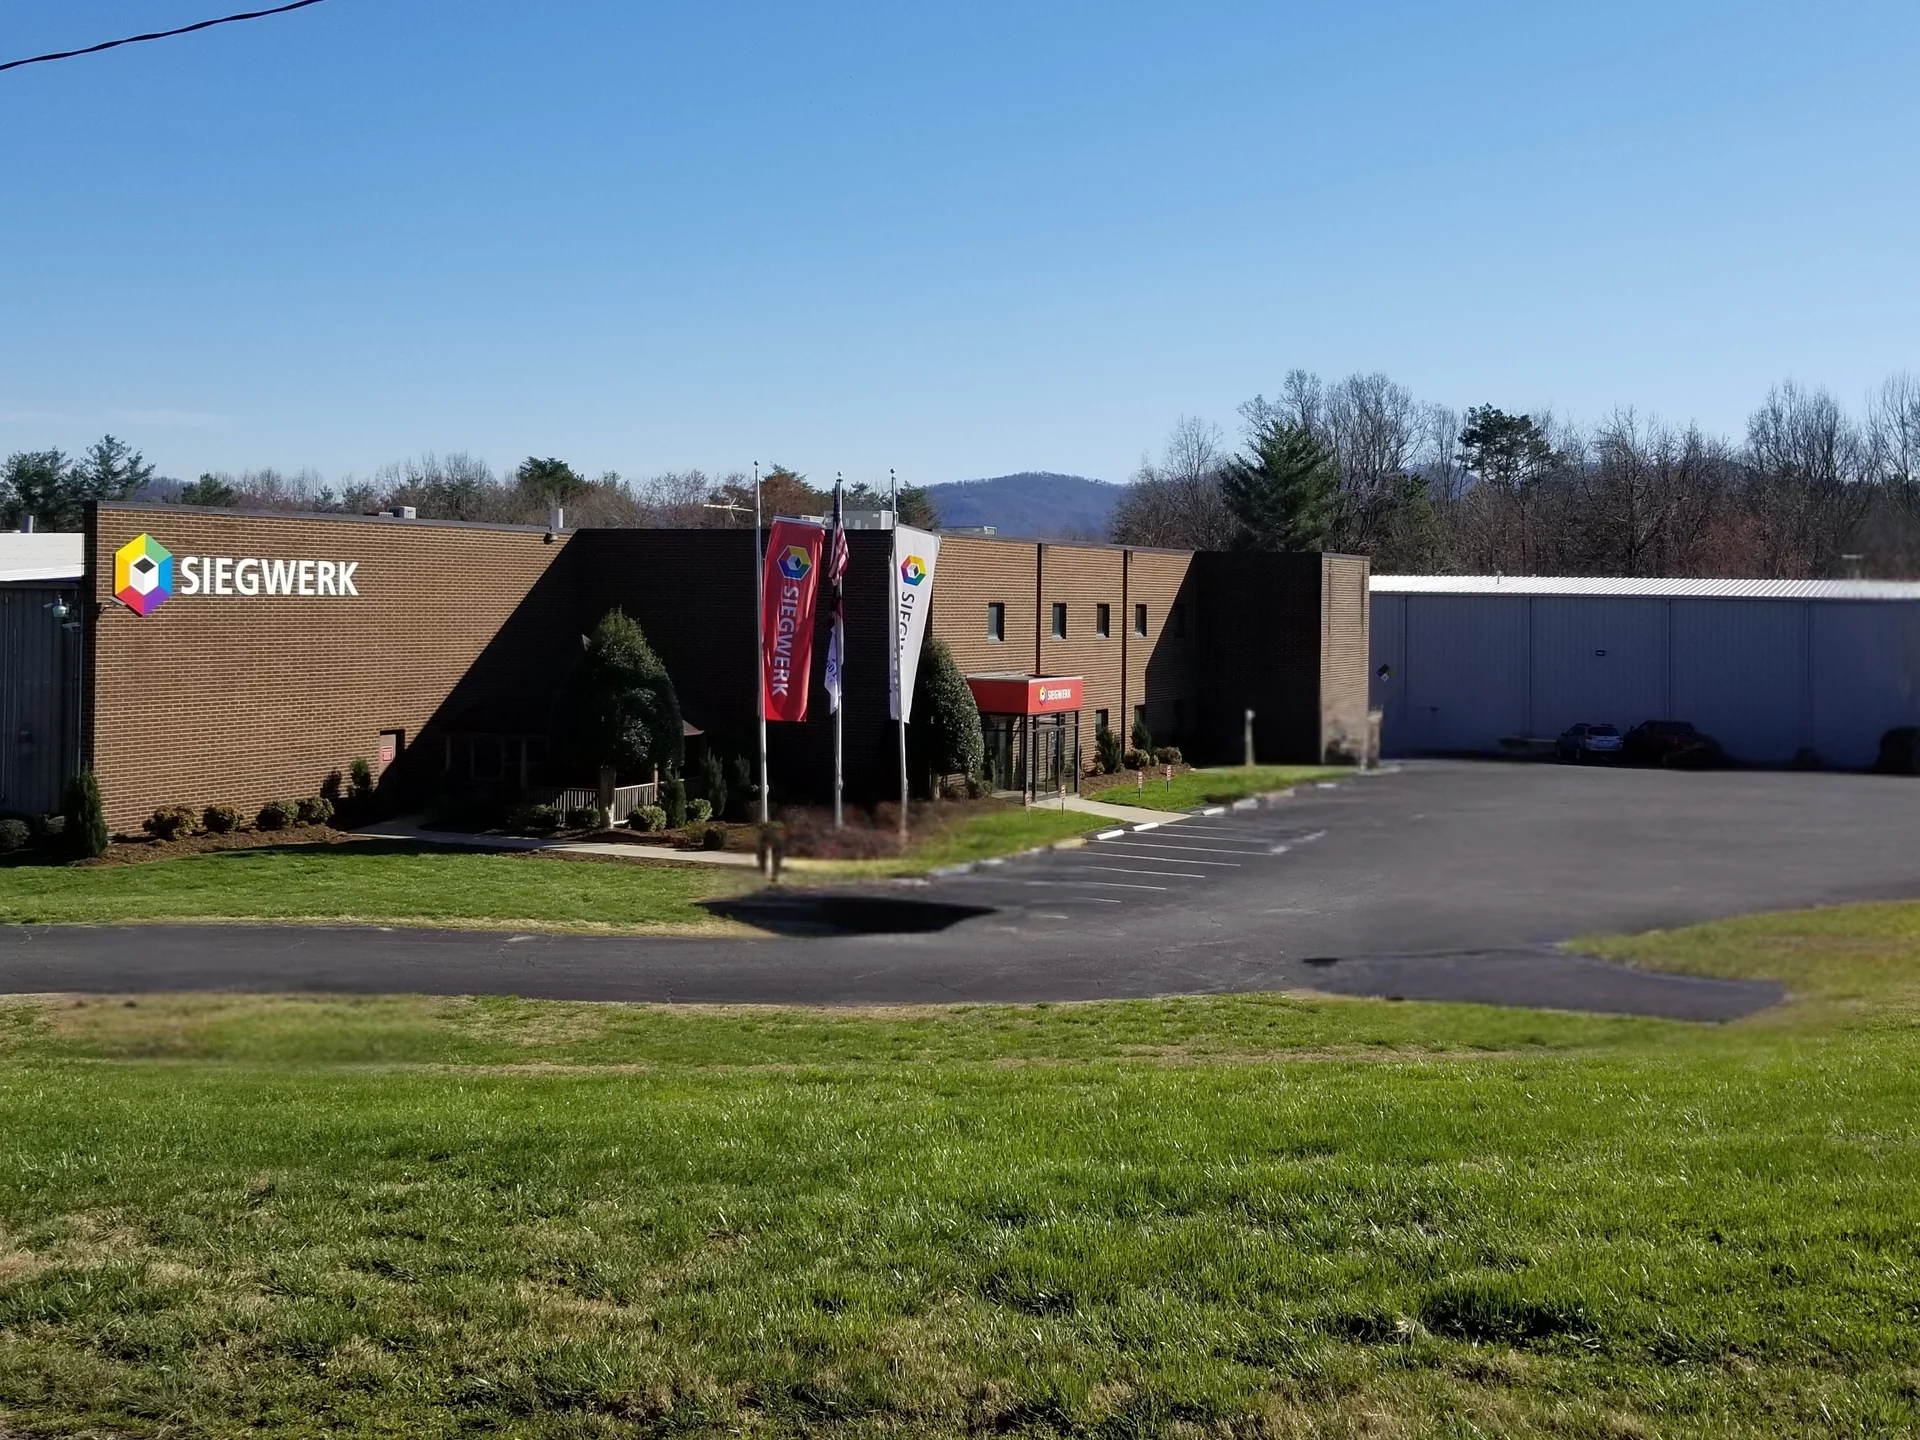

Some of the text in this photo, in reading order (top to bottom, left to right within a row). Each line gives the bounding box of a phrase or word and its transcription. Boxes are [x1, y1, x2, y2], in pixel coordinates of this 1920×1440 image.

[181, 556, 359, 596] SIEGWERK
[773, 585, 799, 697] SIEGWERK
[1047, 688, 1072, 701] SIEGWERK
